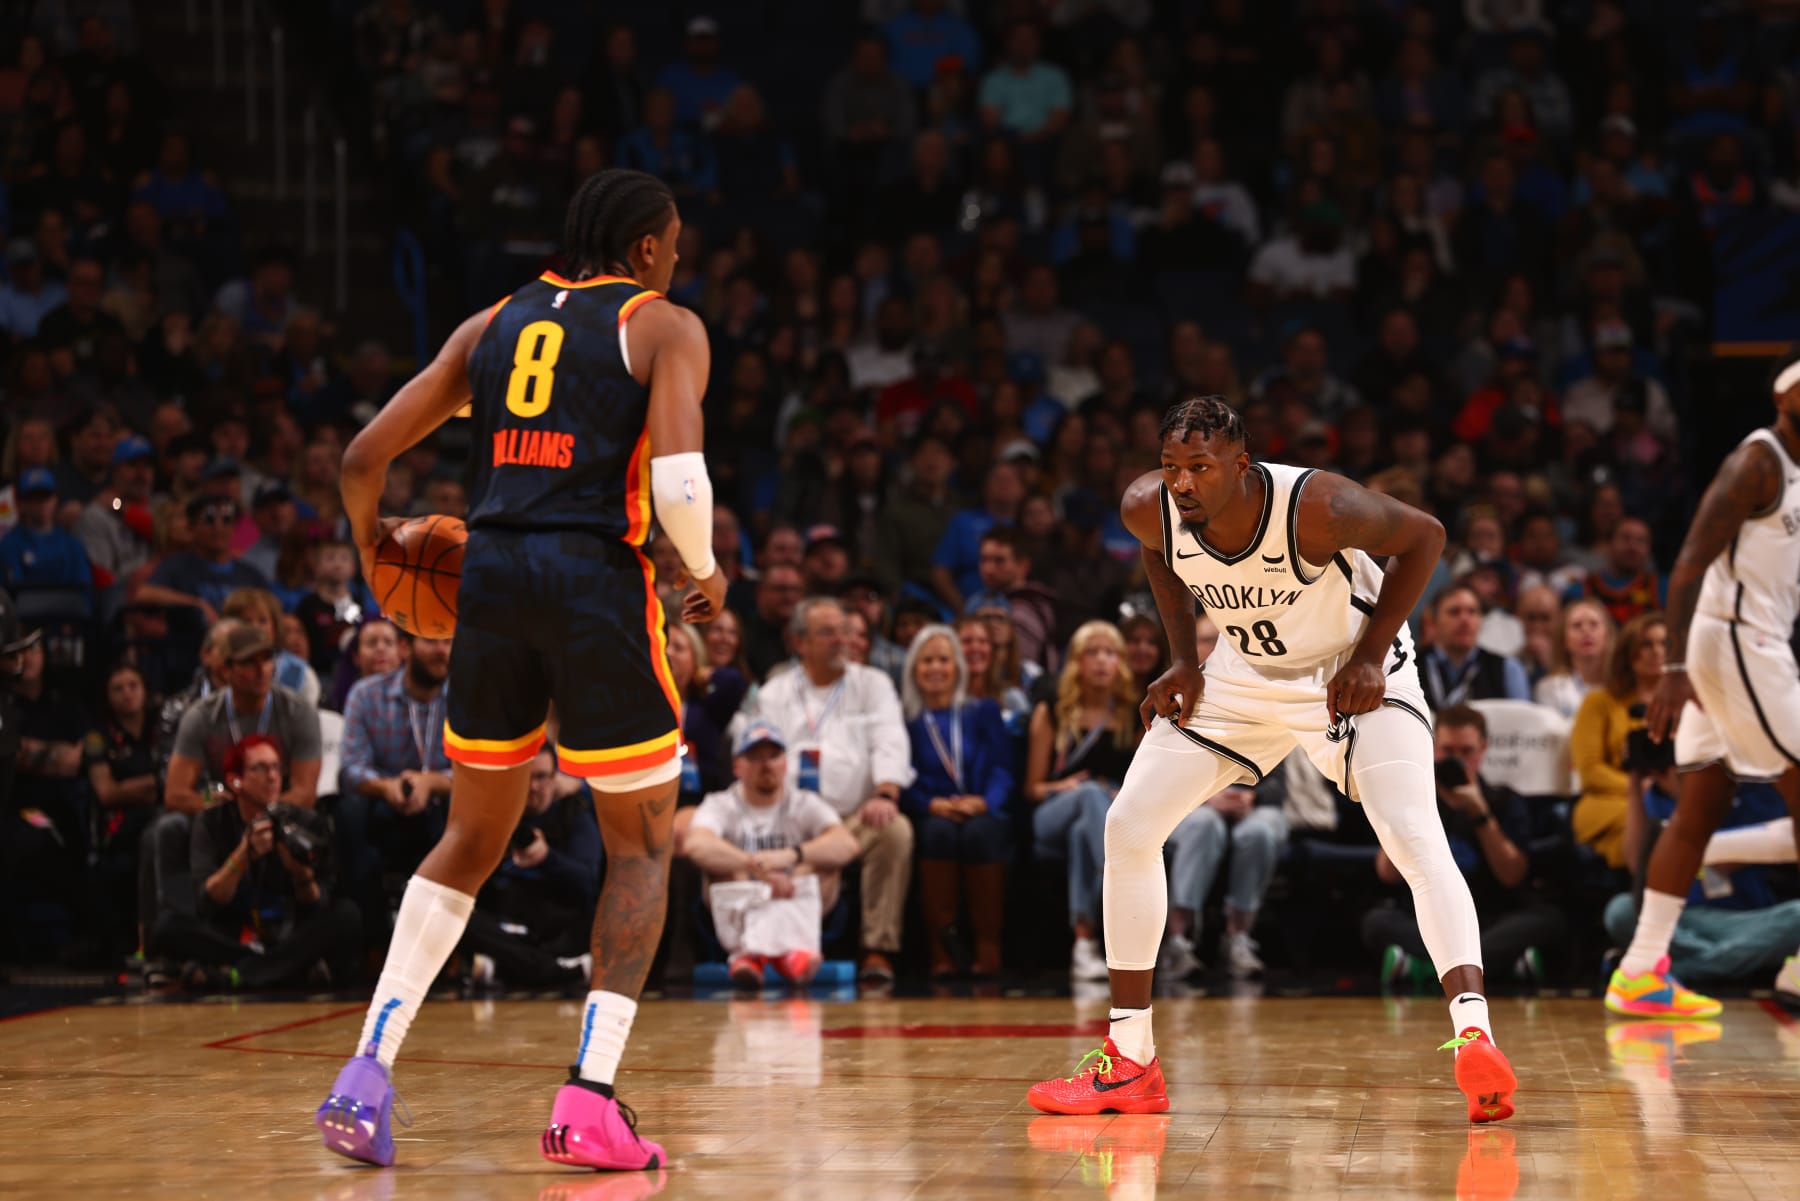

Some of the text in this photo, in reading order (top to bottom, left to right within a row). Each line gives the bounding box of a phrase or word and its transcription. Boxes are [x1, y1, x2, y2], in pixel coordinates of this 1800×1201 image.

[505, 319, 566, 419] 8
[1189, 583, 1304, 610] ROOKLYN
[1225, 619, 1288, 657] 28
